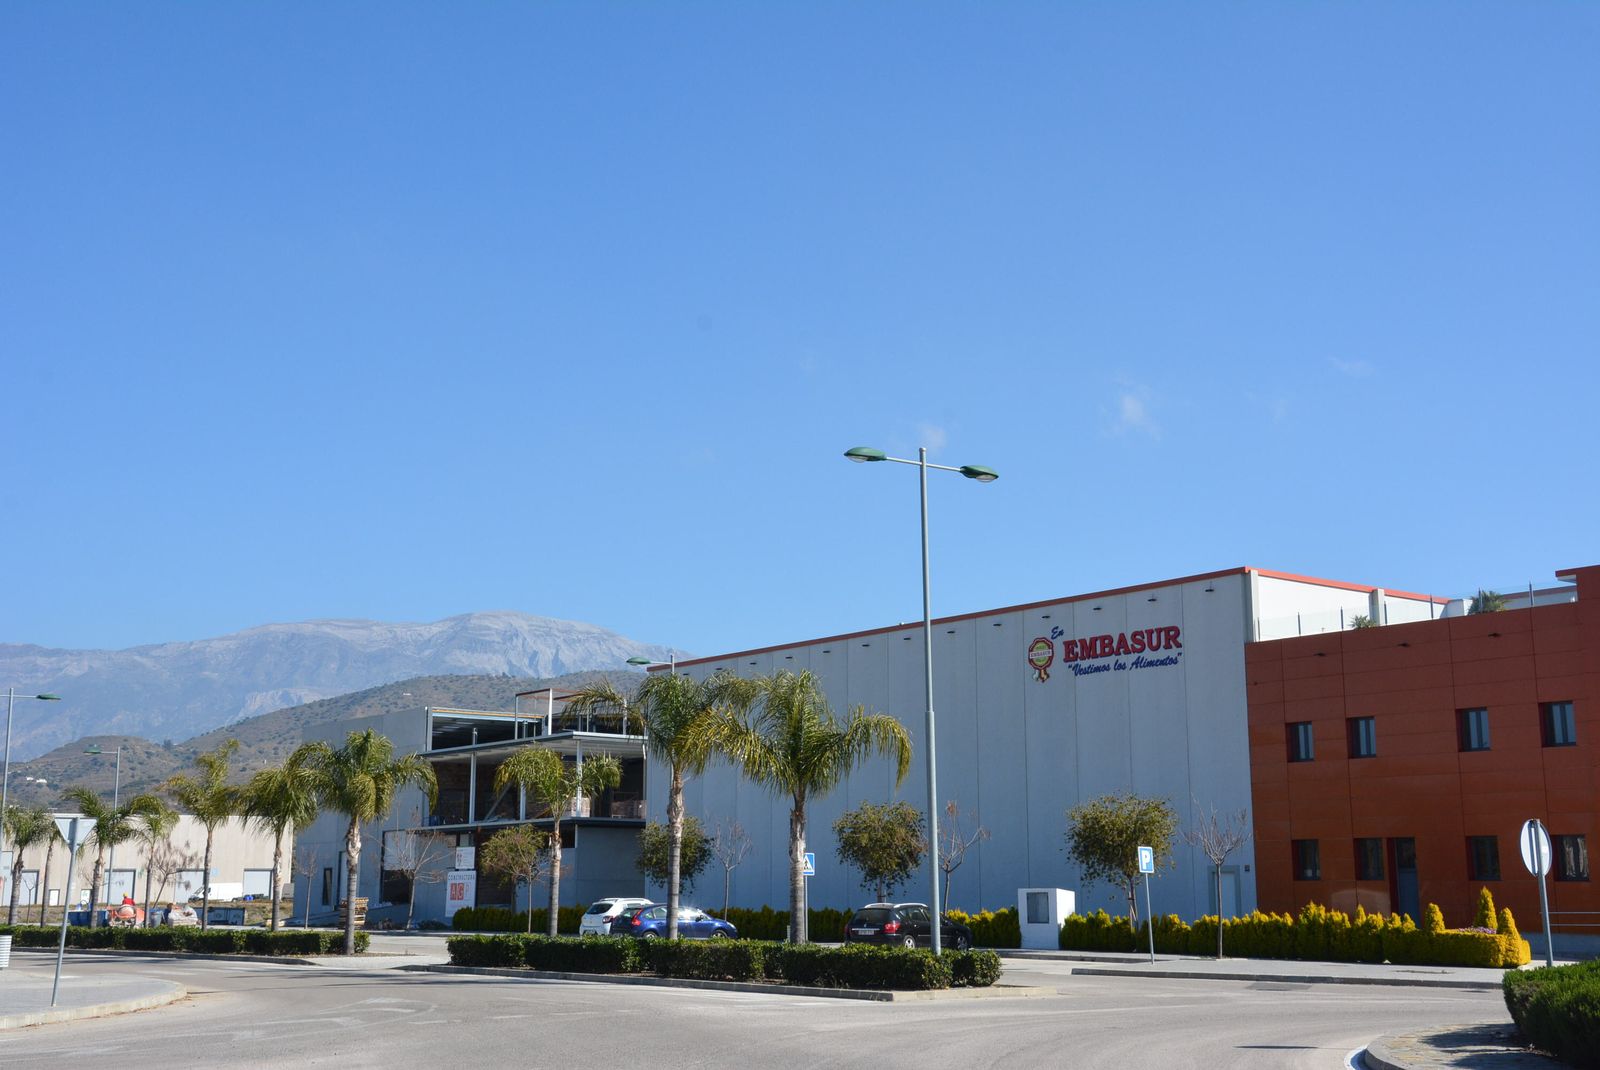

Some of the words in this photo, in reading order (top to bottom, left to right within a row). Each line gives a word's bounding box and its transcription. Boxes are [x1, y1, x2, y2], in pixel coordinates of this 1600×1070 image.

[1051, 626, 1064, 640] En
[1063, 625, 1182, 663] EMBASUR
[1113, 659, 1126, 672] los
[1142, 850, 1151, 870] P
